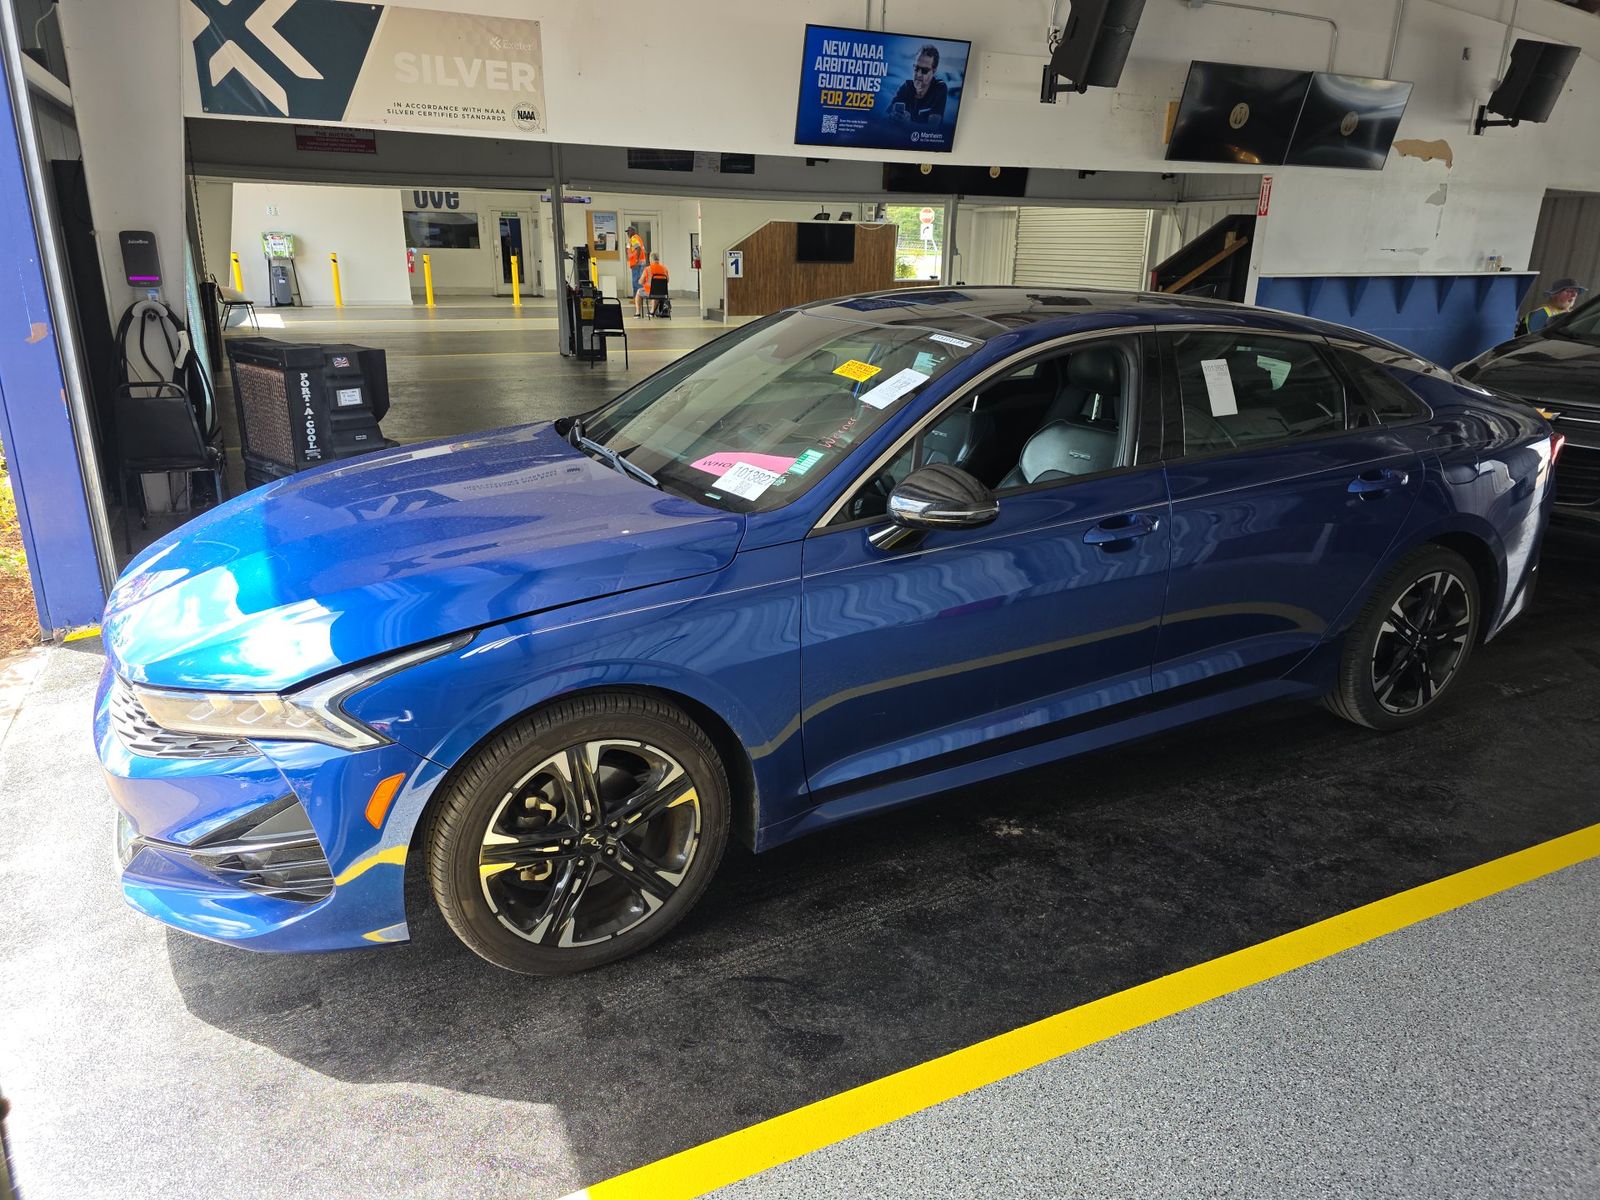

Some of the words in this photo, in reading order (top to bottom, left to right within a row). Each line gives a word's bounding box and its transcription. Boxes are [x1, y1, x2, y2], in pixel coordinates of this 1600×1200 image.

[822, 39, 851, 57] NEW
[852, 42, 884, 60] NAAA
[393, 51, 537, 93] SILVER
[814, 56, 889, 77] ARBITRATION
[818, 73, 882, 92] GUIDELINES
[405, 102, 459, 112] ACCORDANCE
[820, 90, 843, 105] FOR
[845, 91, 875, 108] 2026
[386, 108, 414, 116] SILVER
[417, 111, 459, 119] CERTIFIED
[461, 113, 507, 122] STANDARDS
[517, 110, 536, 121] NAAA
[730, 258, 739, 275] 1
